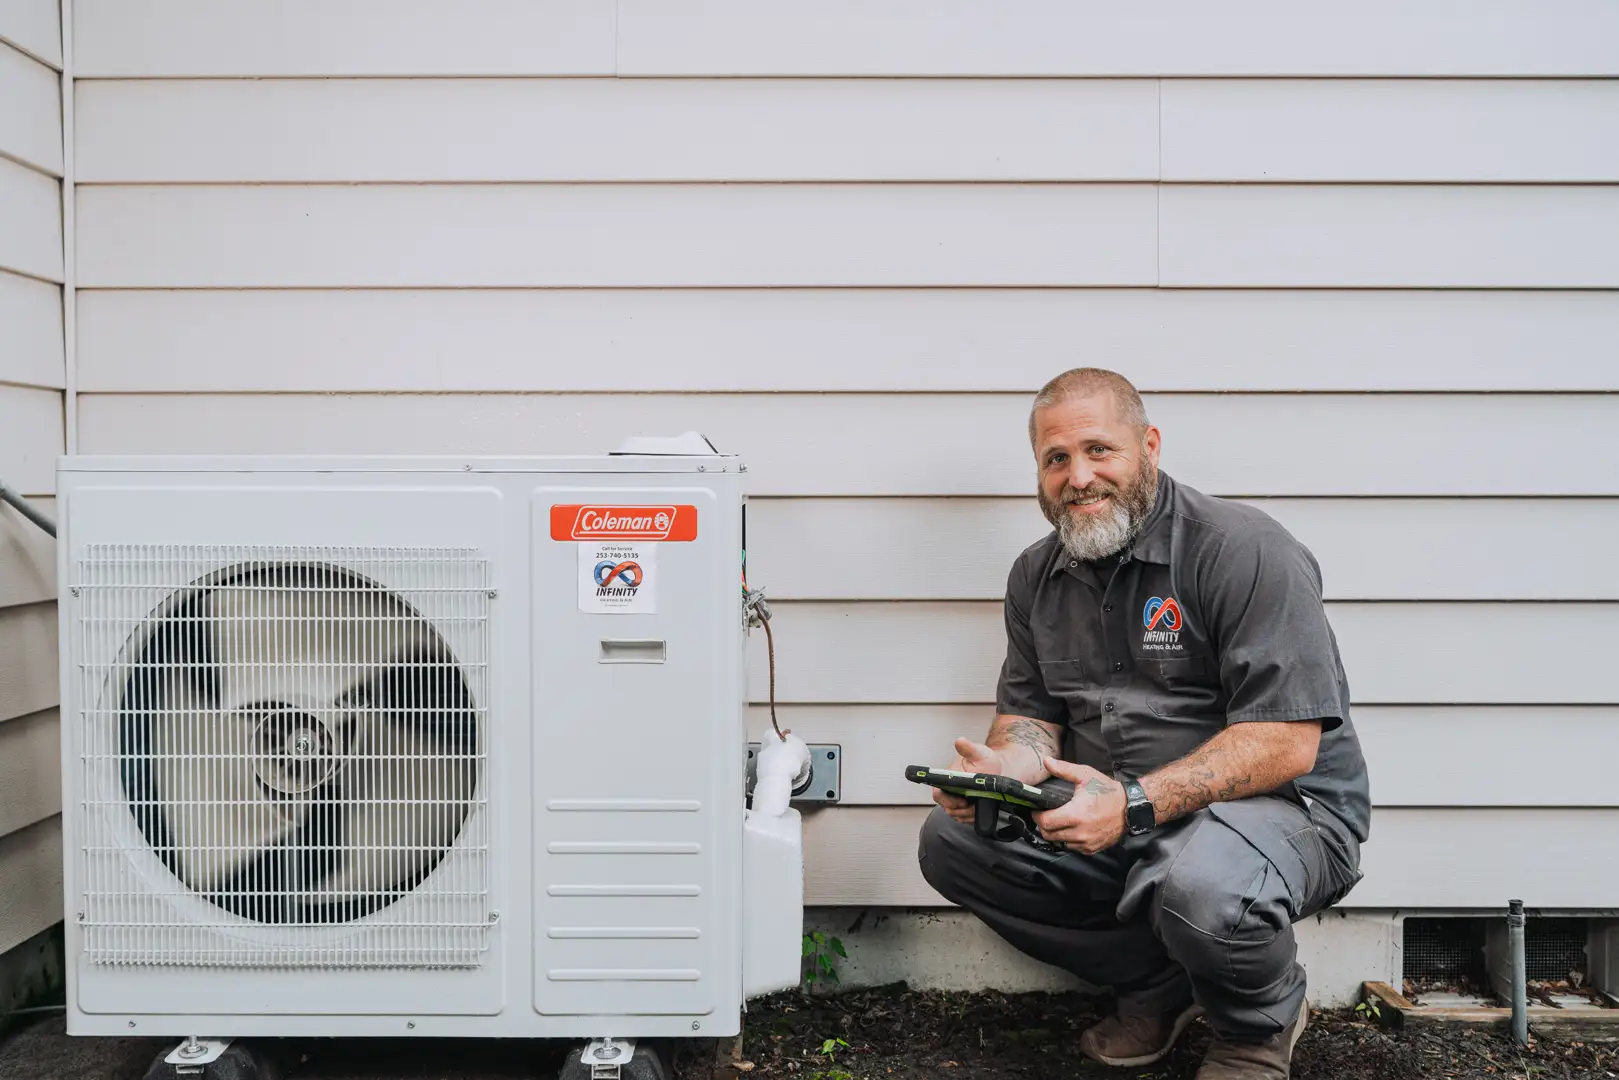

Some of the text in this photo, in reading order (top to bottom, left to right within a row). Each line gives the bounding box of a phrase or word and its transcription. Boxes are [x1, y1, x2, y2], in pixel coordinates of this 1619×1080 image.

[581, 510, 652, 531] Coleman
[596, 587, 638, 597] INFINITY
[1143, 631, 1180, 643] INFINITY
